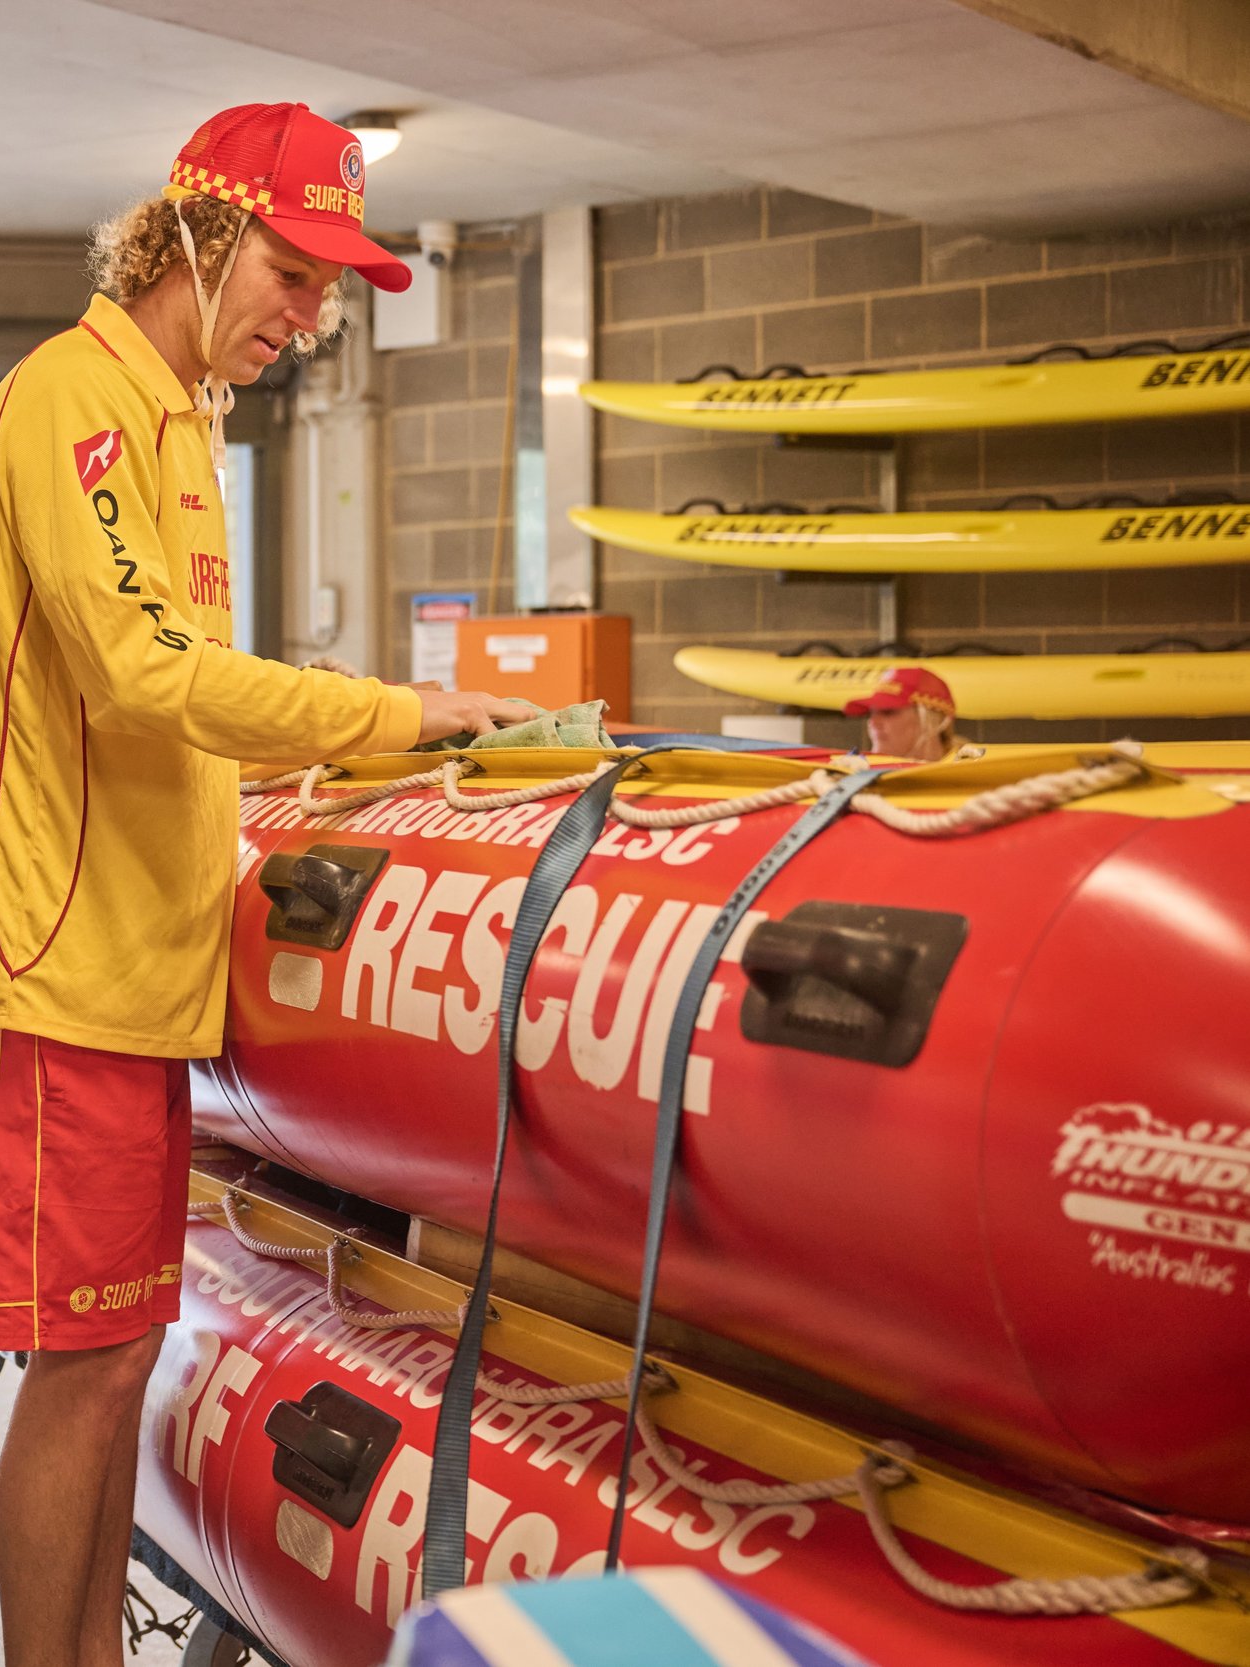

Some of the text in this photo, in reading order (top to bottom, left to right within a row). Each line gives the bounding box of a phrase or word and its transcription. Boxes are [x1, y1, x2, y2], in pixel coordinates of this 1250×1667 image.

[303, 184, 347, 213] SURF
[694, 383, 857, 412] BENNETT
[676, 522, 835, 548] BENNETT
[588, 815, 741, 866] LSC
[340, 864, 769, 1117] RESCUE
[99, 1278, 144, 1311] SURF
[197, 1251, 364, 1345] SOUTH
[596, 1444, 816, 1576] SLSC
